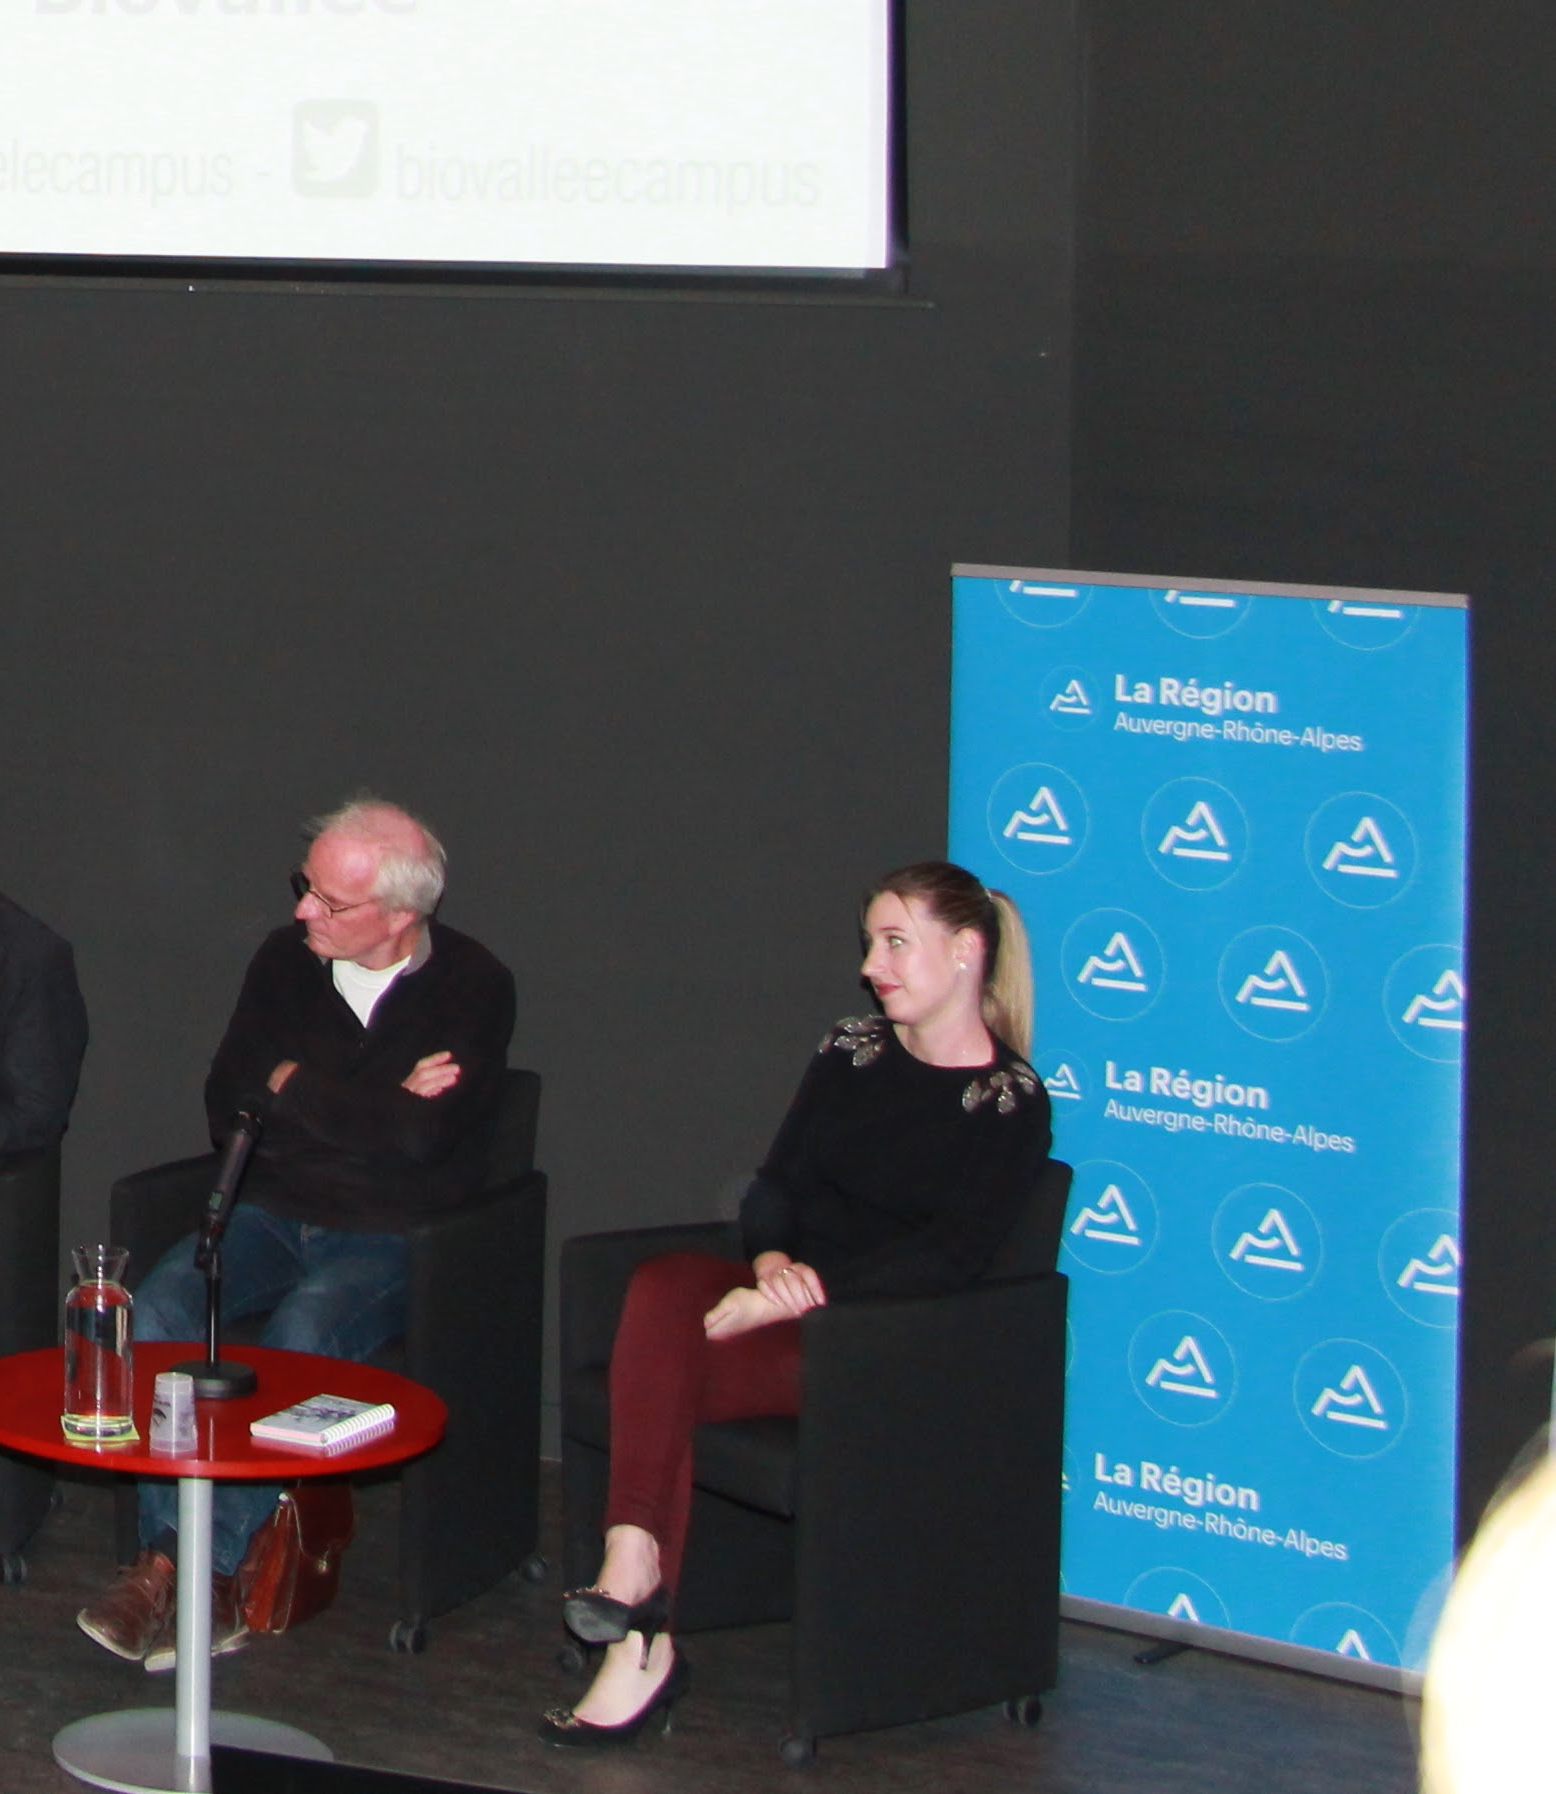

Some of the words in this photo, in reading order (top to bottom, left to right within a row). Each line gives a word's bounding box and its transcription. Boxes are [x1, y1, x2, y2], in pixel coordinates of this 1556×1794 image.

[396, 143, 821, 213] biovalleecampus
[1115, 673, 1153, 704] La
[1160, 677, 1278, 716] Région
[1114, 711, 1362, 752] Auvergne-Rhône-Alpes
[1105, 1060, 1142, 1092] La
[1150, 1065, 1268, 1108] Région
[1104, 1098, 1354, 1152] Auvergne-Rhône-Alpes
[1094, 1452, 1133, 1486] La
[1141, 1459, 1260, 1511] Région
[1093, 1491, 1348, 1560] Auvergne-Rhône-Alpes
